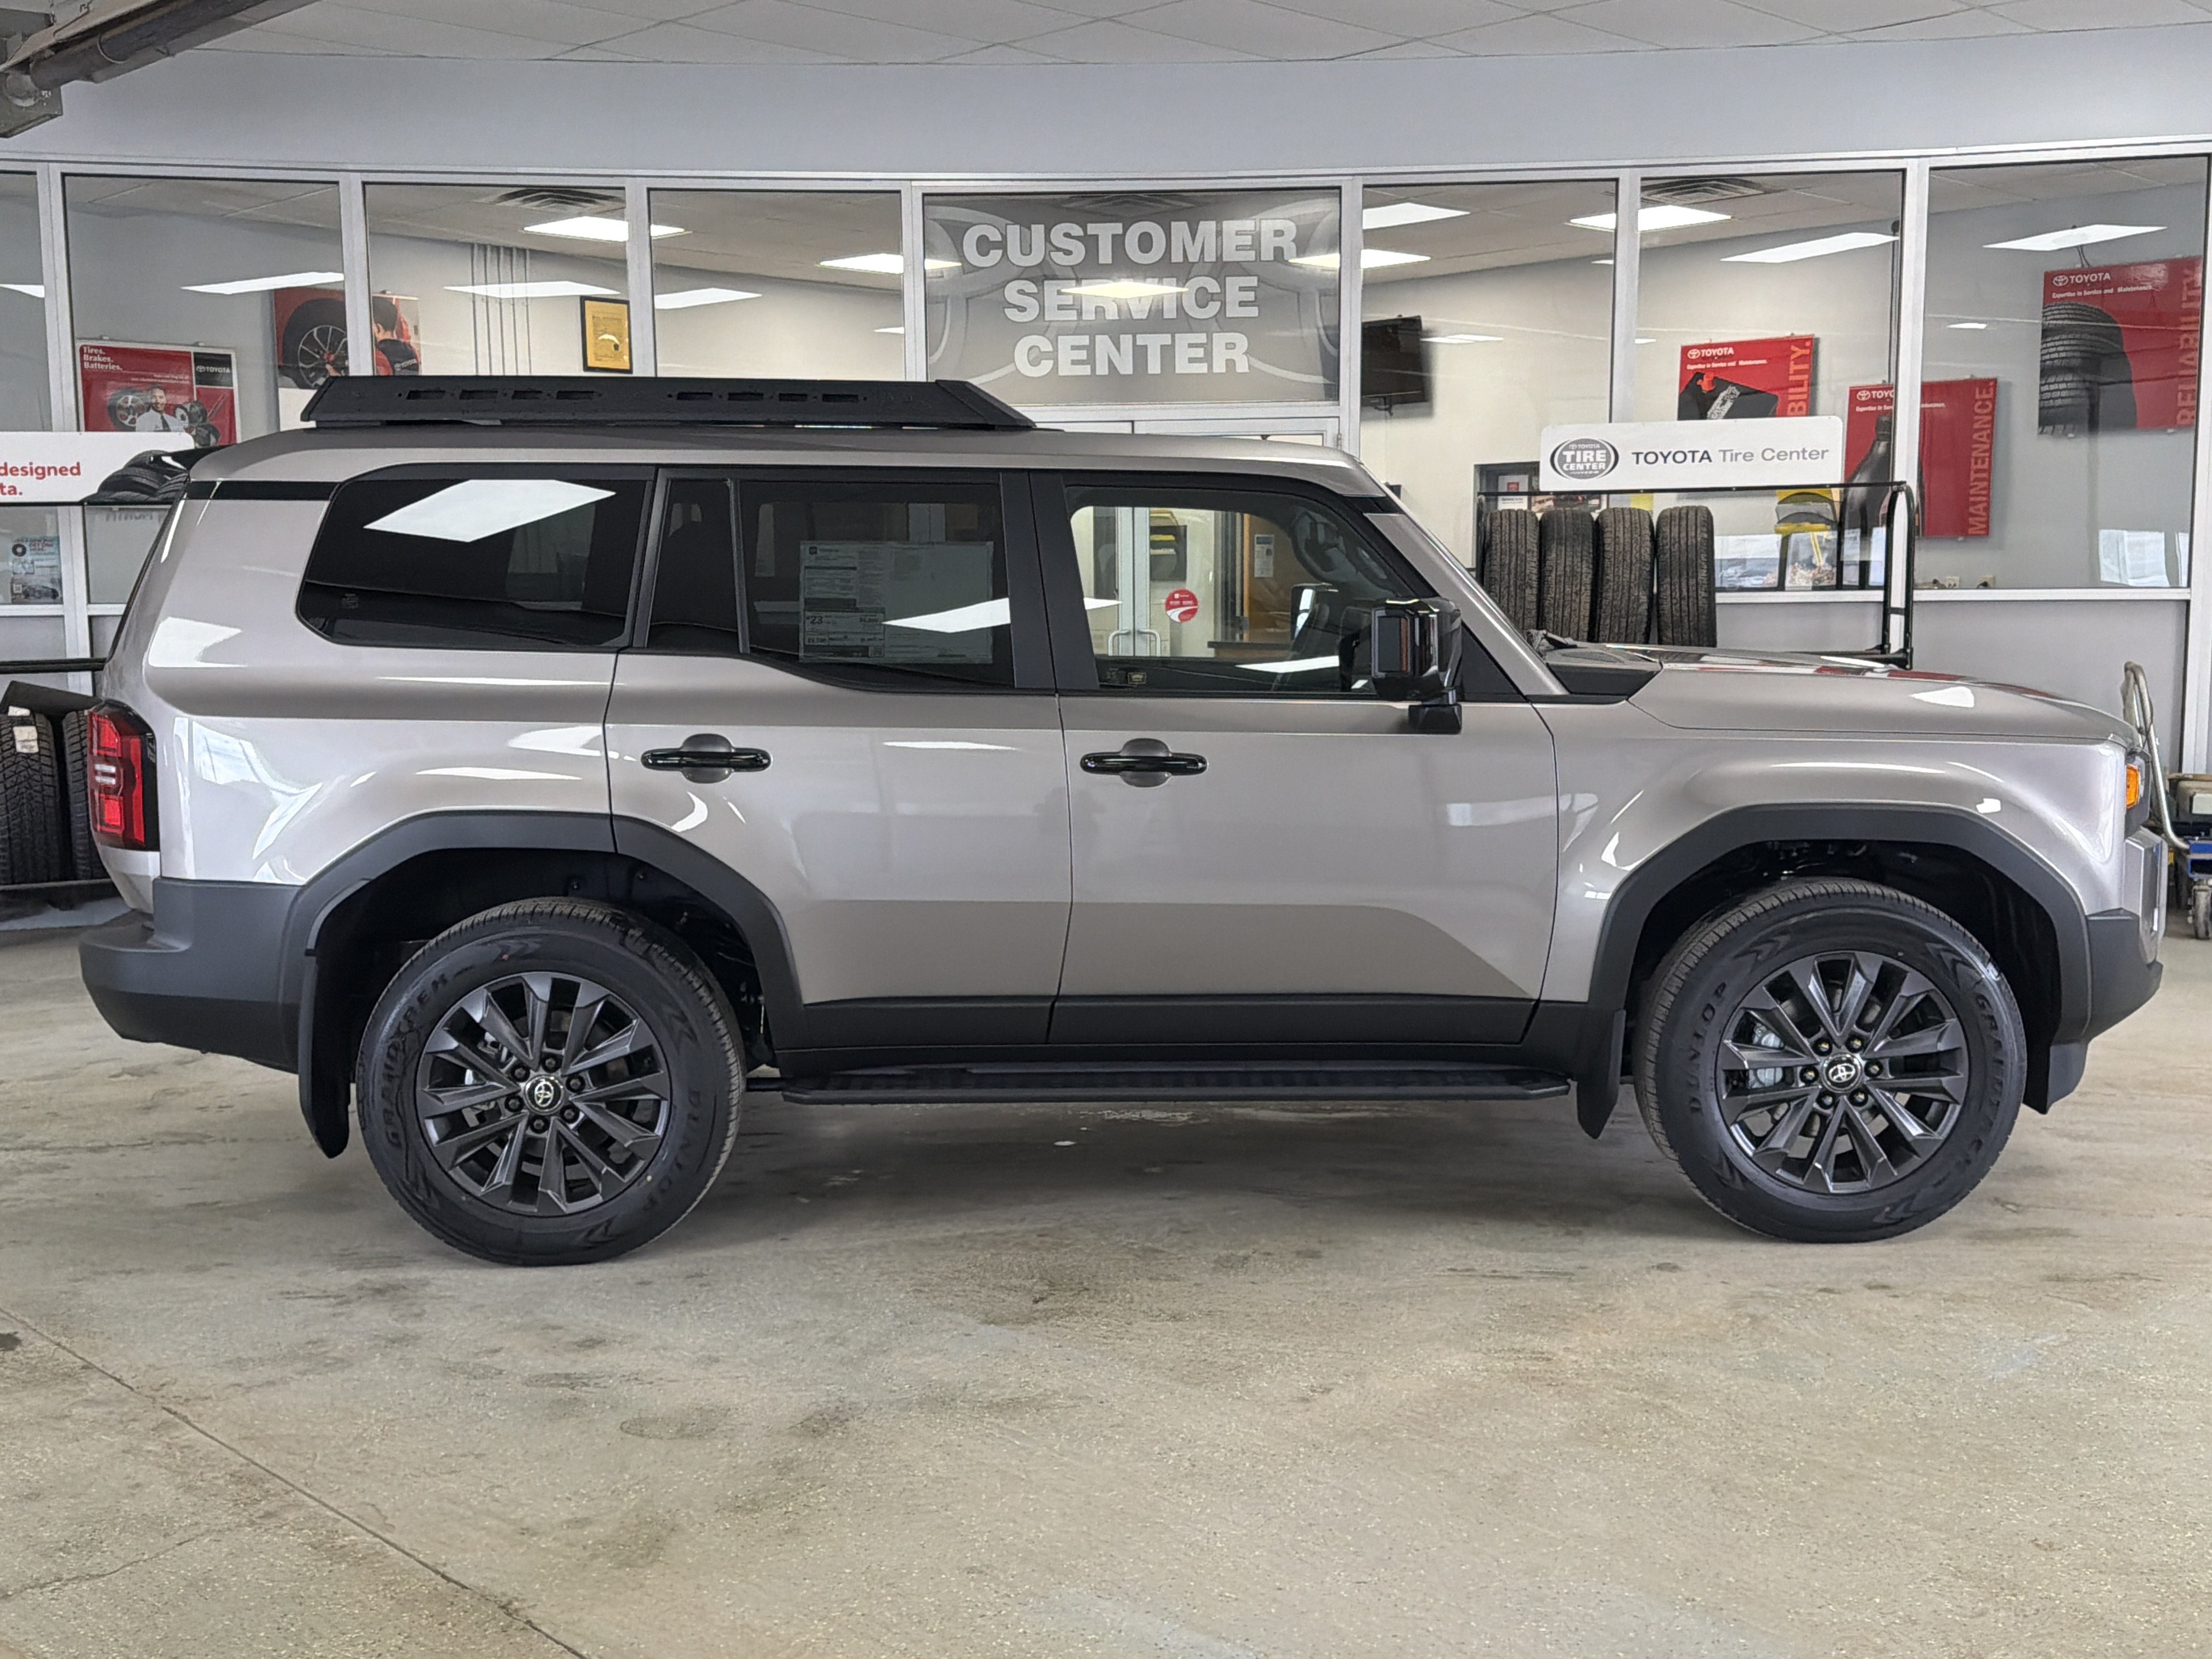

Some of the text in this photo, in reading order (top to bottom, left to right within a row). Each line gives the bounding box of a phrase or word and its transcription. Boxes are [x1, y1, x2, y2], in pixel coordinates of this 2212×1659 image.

[962, 218, 1298, 268] CUSTOMER
[2069, 273, 2111, 284] TOYOTA
[1003, 275, 1259, 323] SERVICE
[83, 346, 105, 354] Tires.
[1013, 332, 1249, 377] CENTER
[1701, 347, 1734, 357] TOYOTA
[83, 354, 114, 363] Brakes.
[83, 362, 123, 370] Batteries.
[1871, 390, 1895, 399] TOYO
[1562, 449, 1607, 463] TIRE
[1631, 446, 1830, 466] TOYOTA Tire Center
[1968, 381, 1994, 535] MAINTENANCE.
[0, 461, 81, 480] designed
[1688, 982, 1728, 1116] DUNLOP
